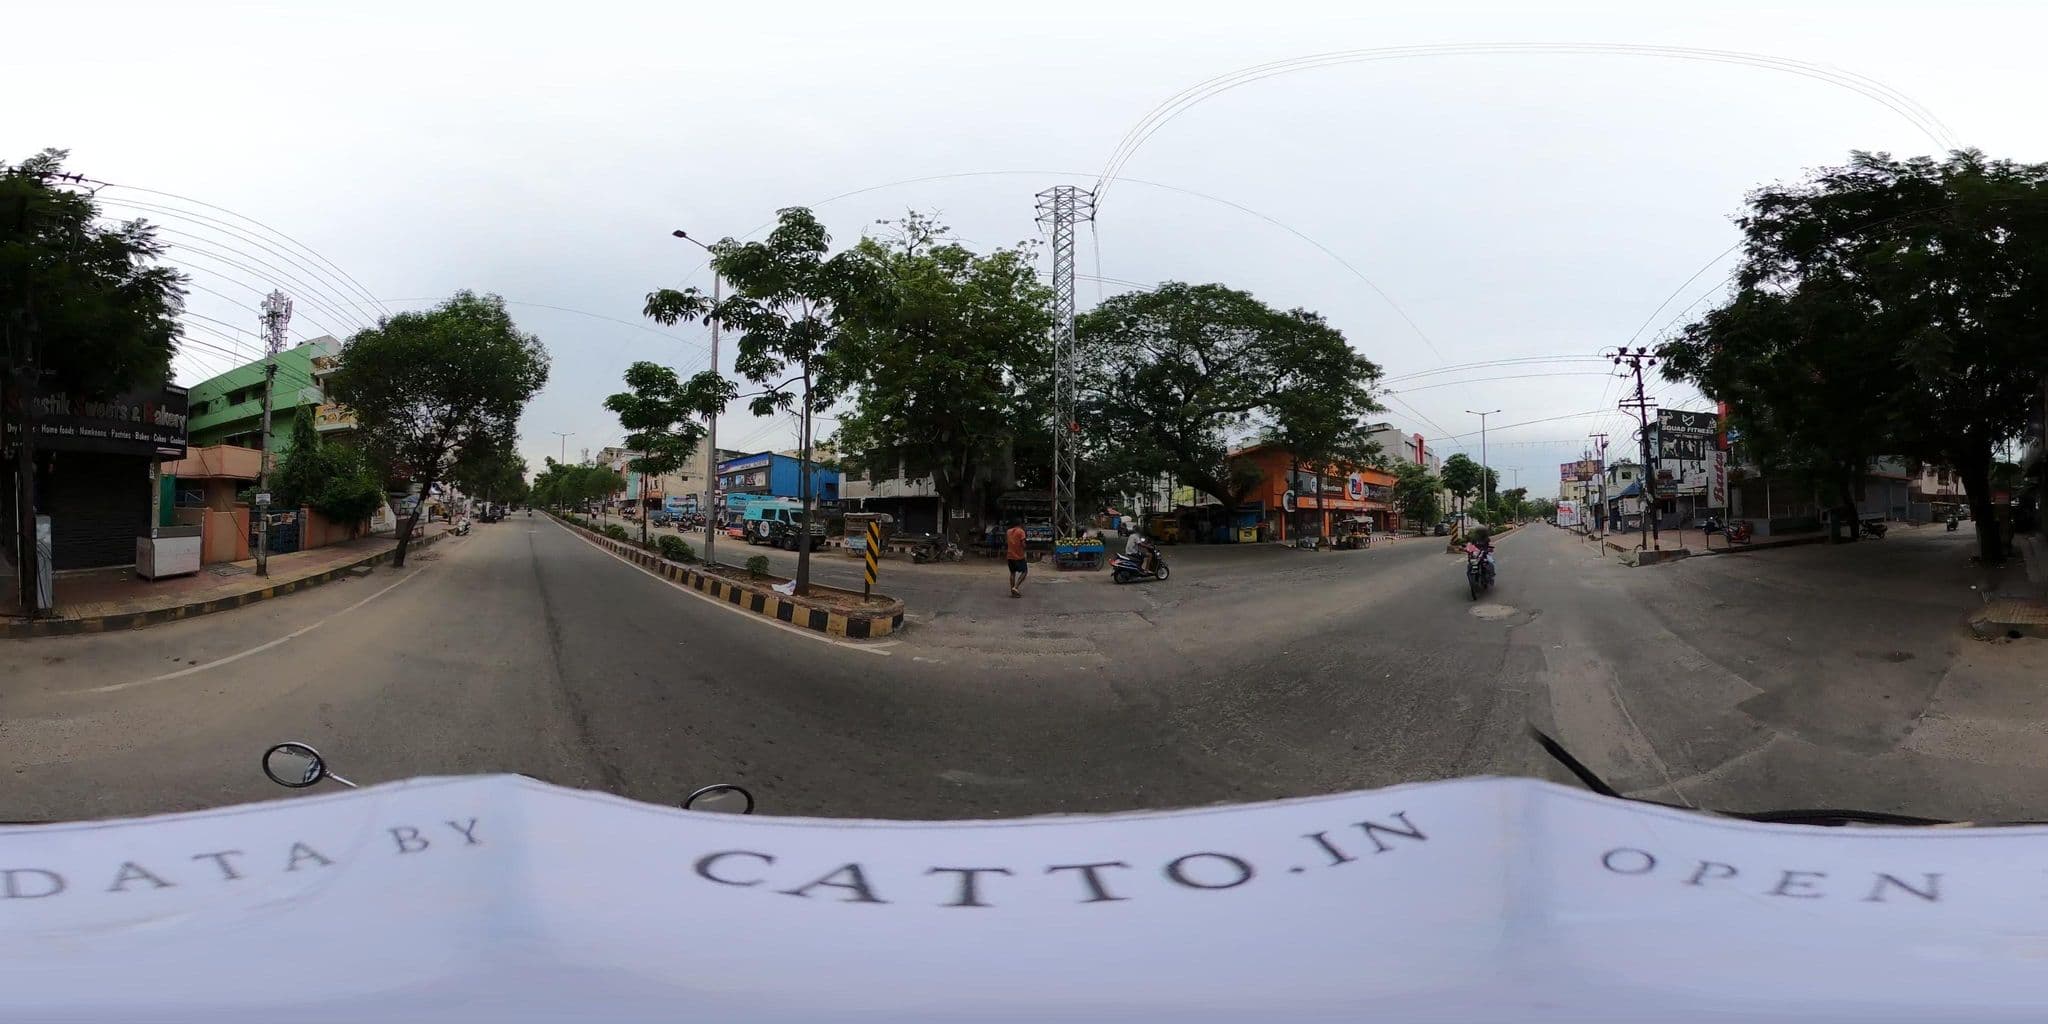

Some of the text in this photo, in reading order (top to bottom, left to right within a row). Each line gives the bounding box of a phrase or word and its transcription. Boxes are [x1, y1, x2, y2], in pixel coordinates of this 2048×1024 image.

[42, 424, 58, 434] Home
[1713, 452, 1725, 506] Bata
[0, 817, 482, 899] DATA BY
[694, 811, 1430, 908] CATTO.IN
[1601, 847, 1945, 903] OPEN
